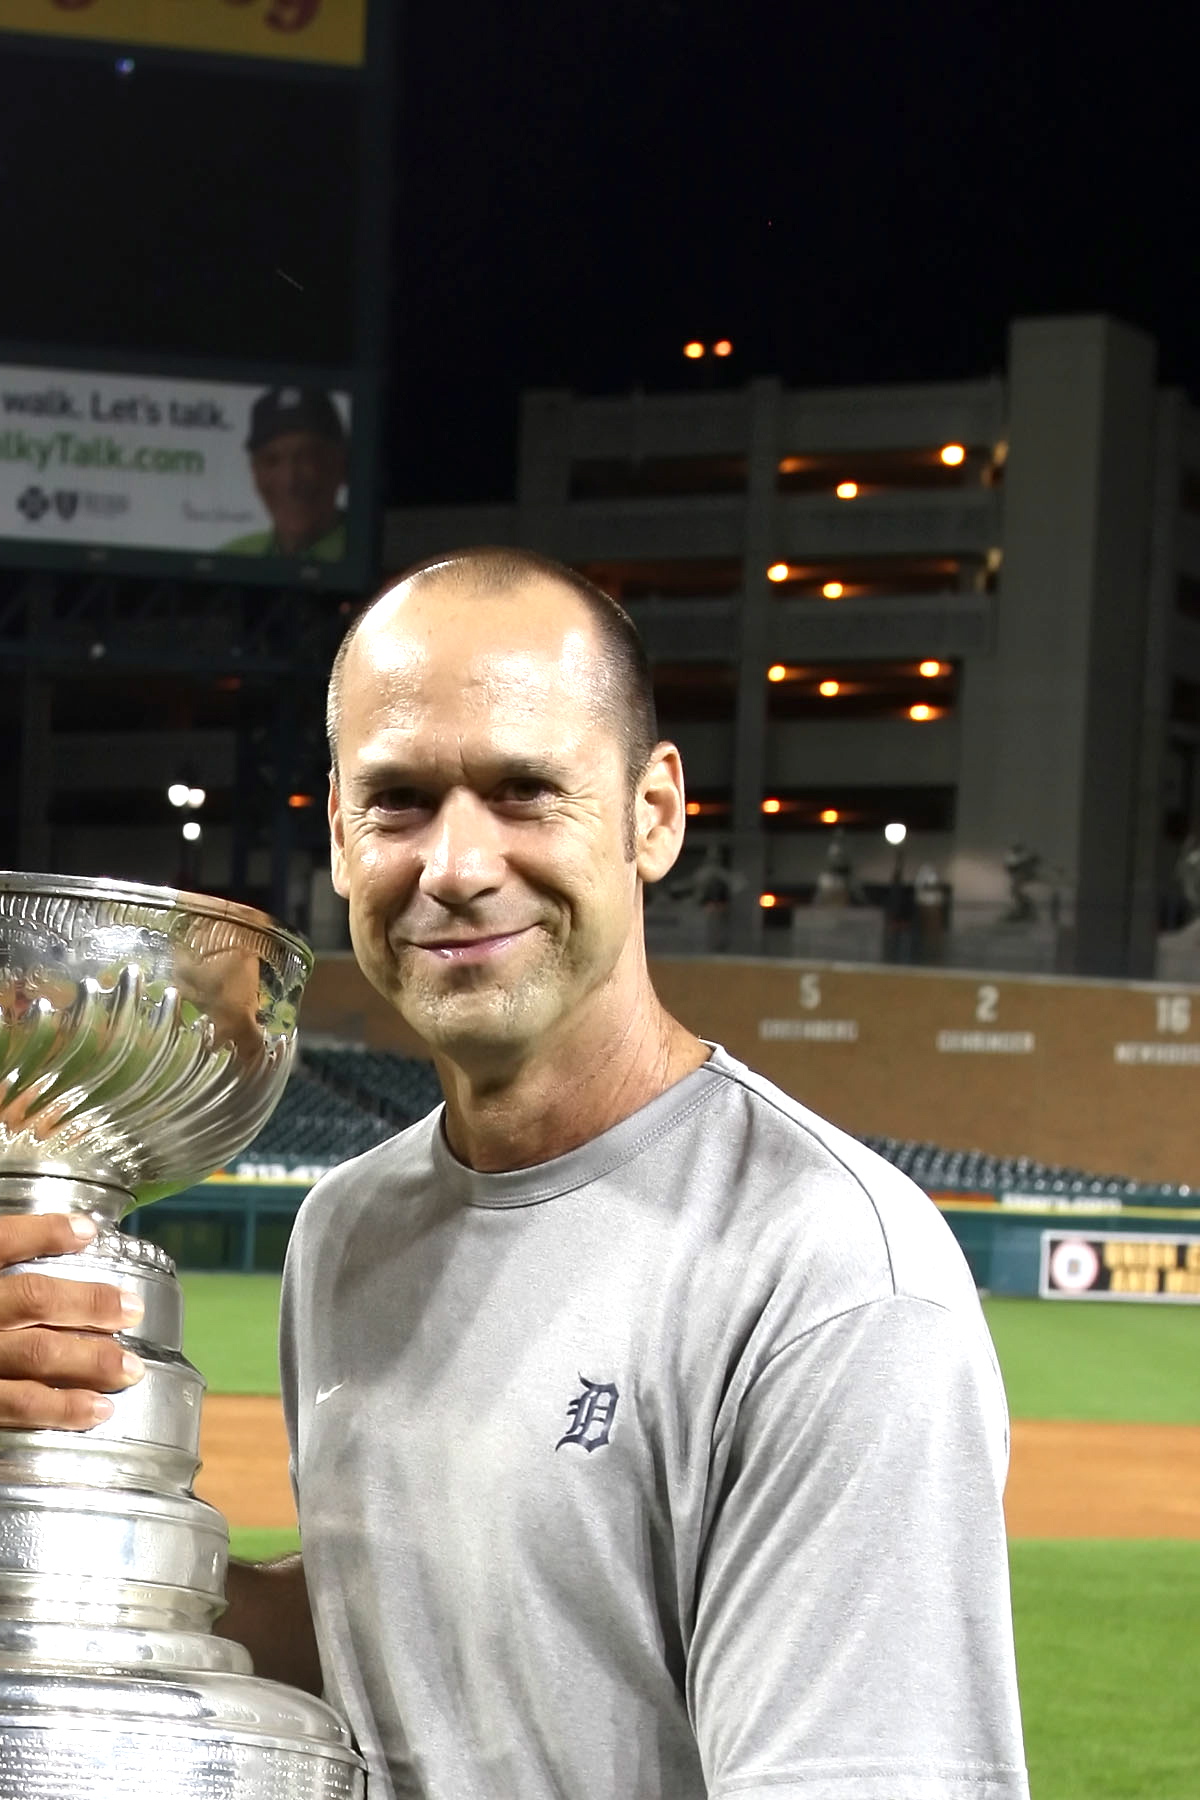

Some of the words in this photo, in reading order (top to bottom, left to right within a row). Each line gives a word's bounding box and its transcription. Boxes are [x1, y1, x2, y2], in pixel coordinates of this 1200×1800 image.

[3, 389, 85, 421] walk.
[90, 391, 162, 426] Let's
[168, 397, 236, 432] talk.
[801, 974, 820, 1010] 5
[977, 985, 999, 1022] 2
[1157, 996, 1192, 1034] 16
[555, 1371, 620, 1453] D
